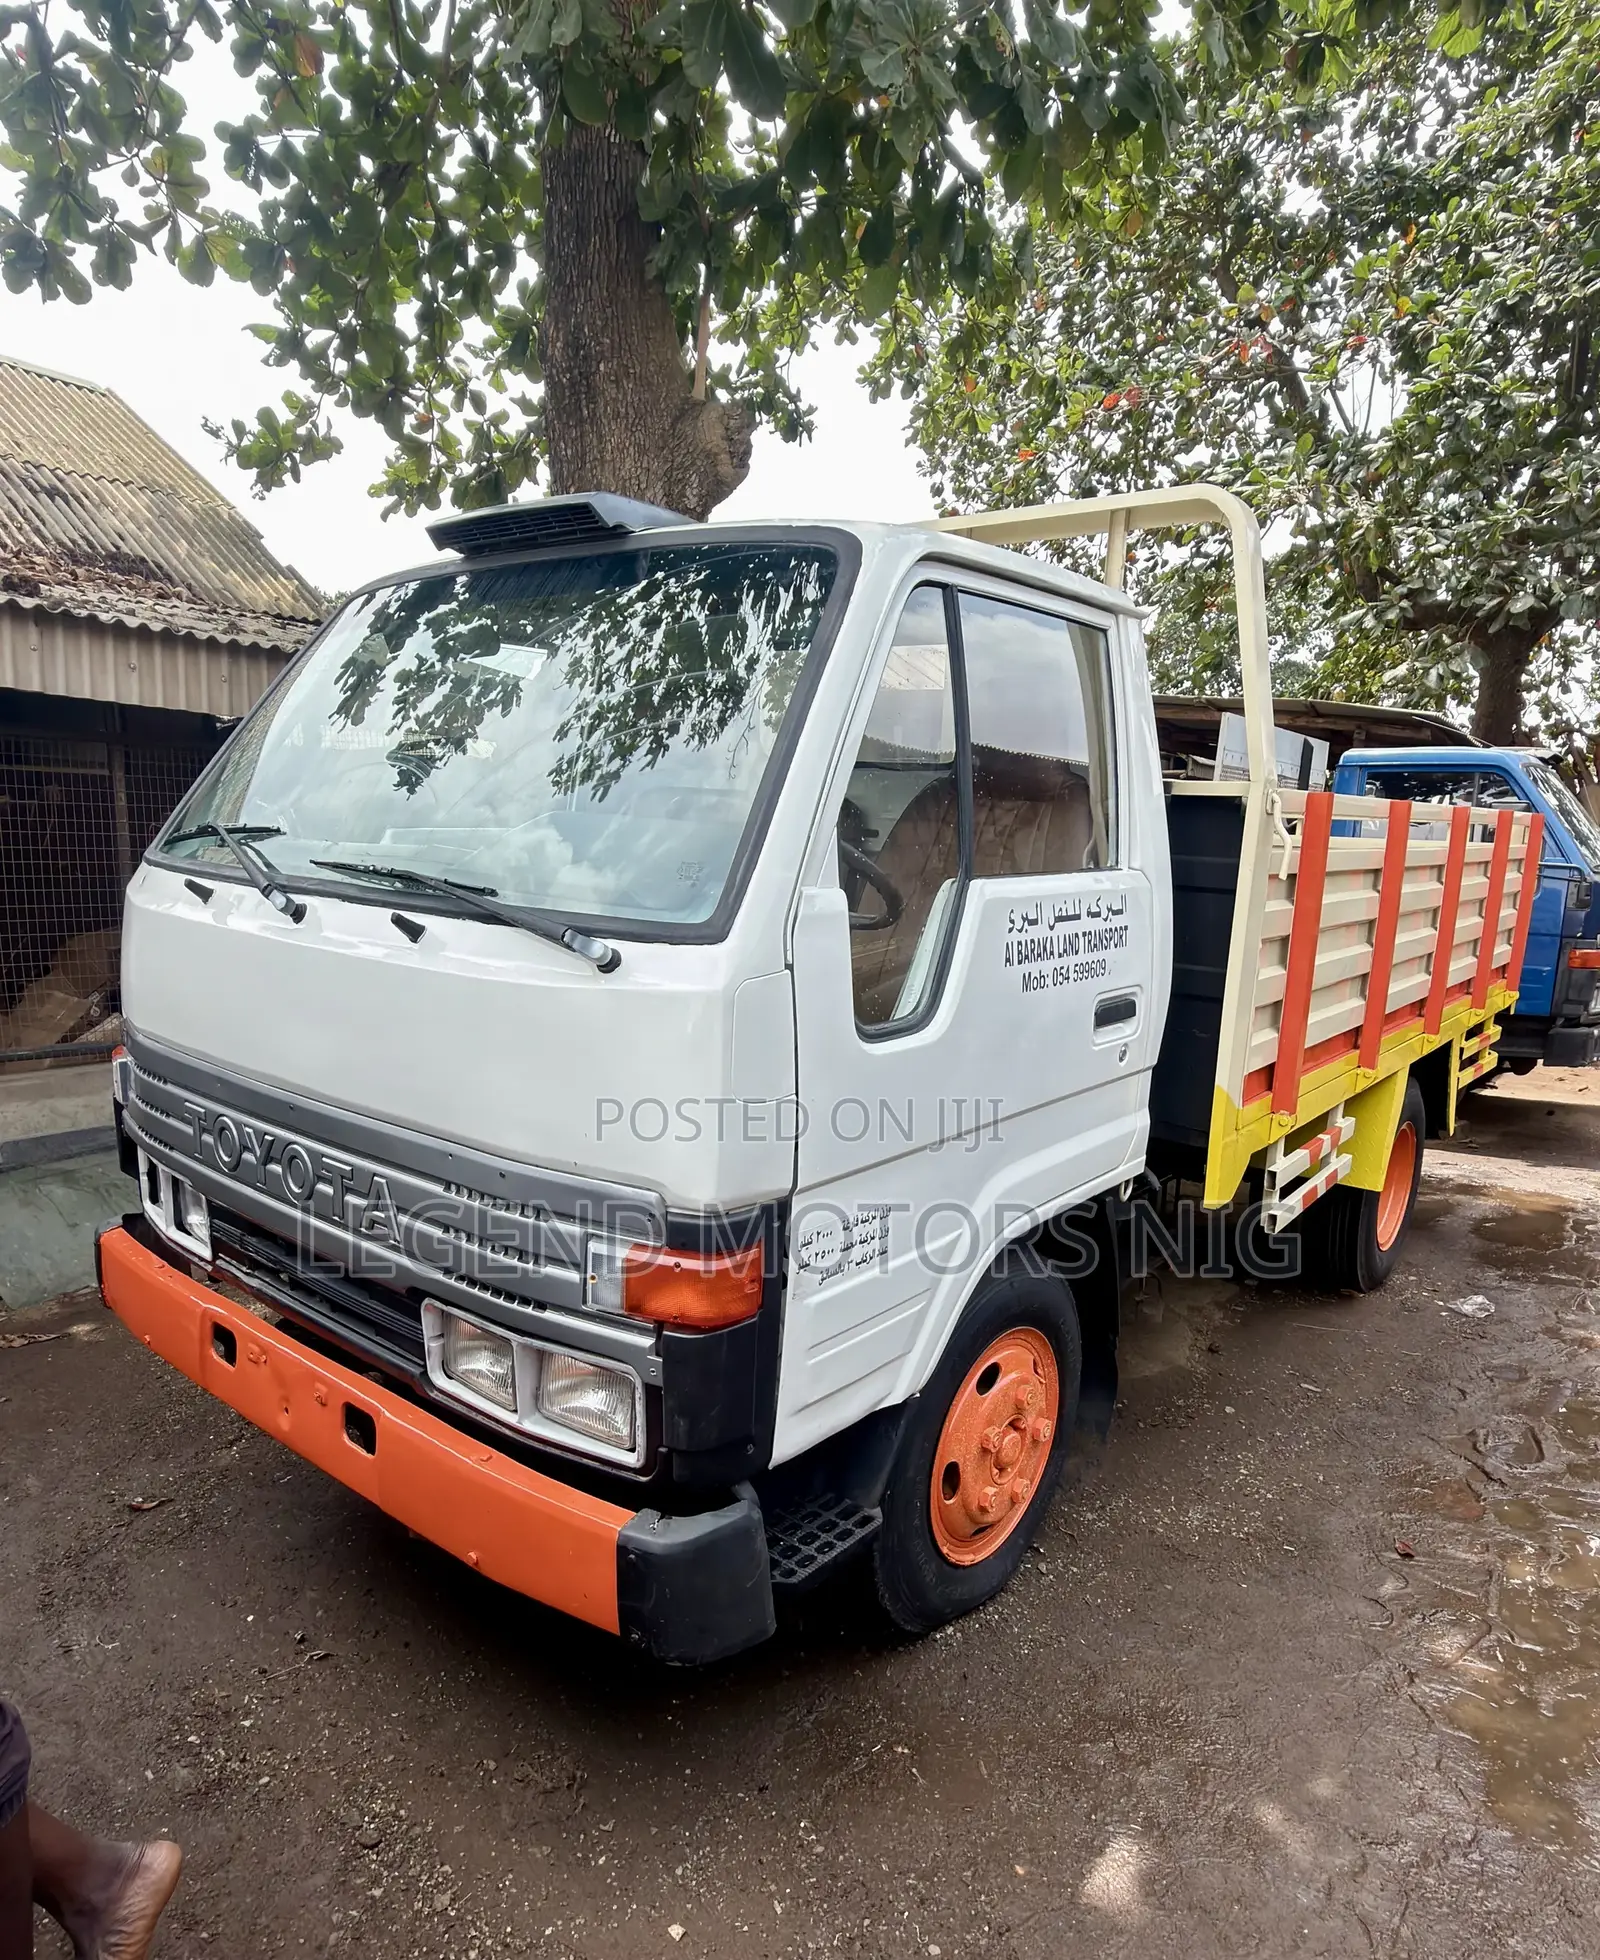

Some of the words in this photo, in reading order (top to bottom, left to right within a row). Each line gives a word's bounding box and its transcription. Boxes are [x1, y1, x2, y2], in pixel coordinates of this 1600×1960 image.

[1017, 935, 1055, 966] BARAKA
[1057, 932, 1080, 959] LAND
[1082, 925, 1129, 953] TRANSPORT
[1021, 969, 1049, 993] Mob:
[1052, 965, 1070, 987] 054
[184, 1101, 402, 1244] TOYOTA
